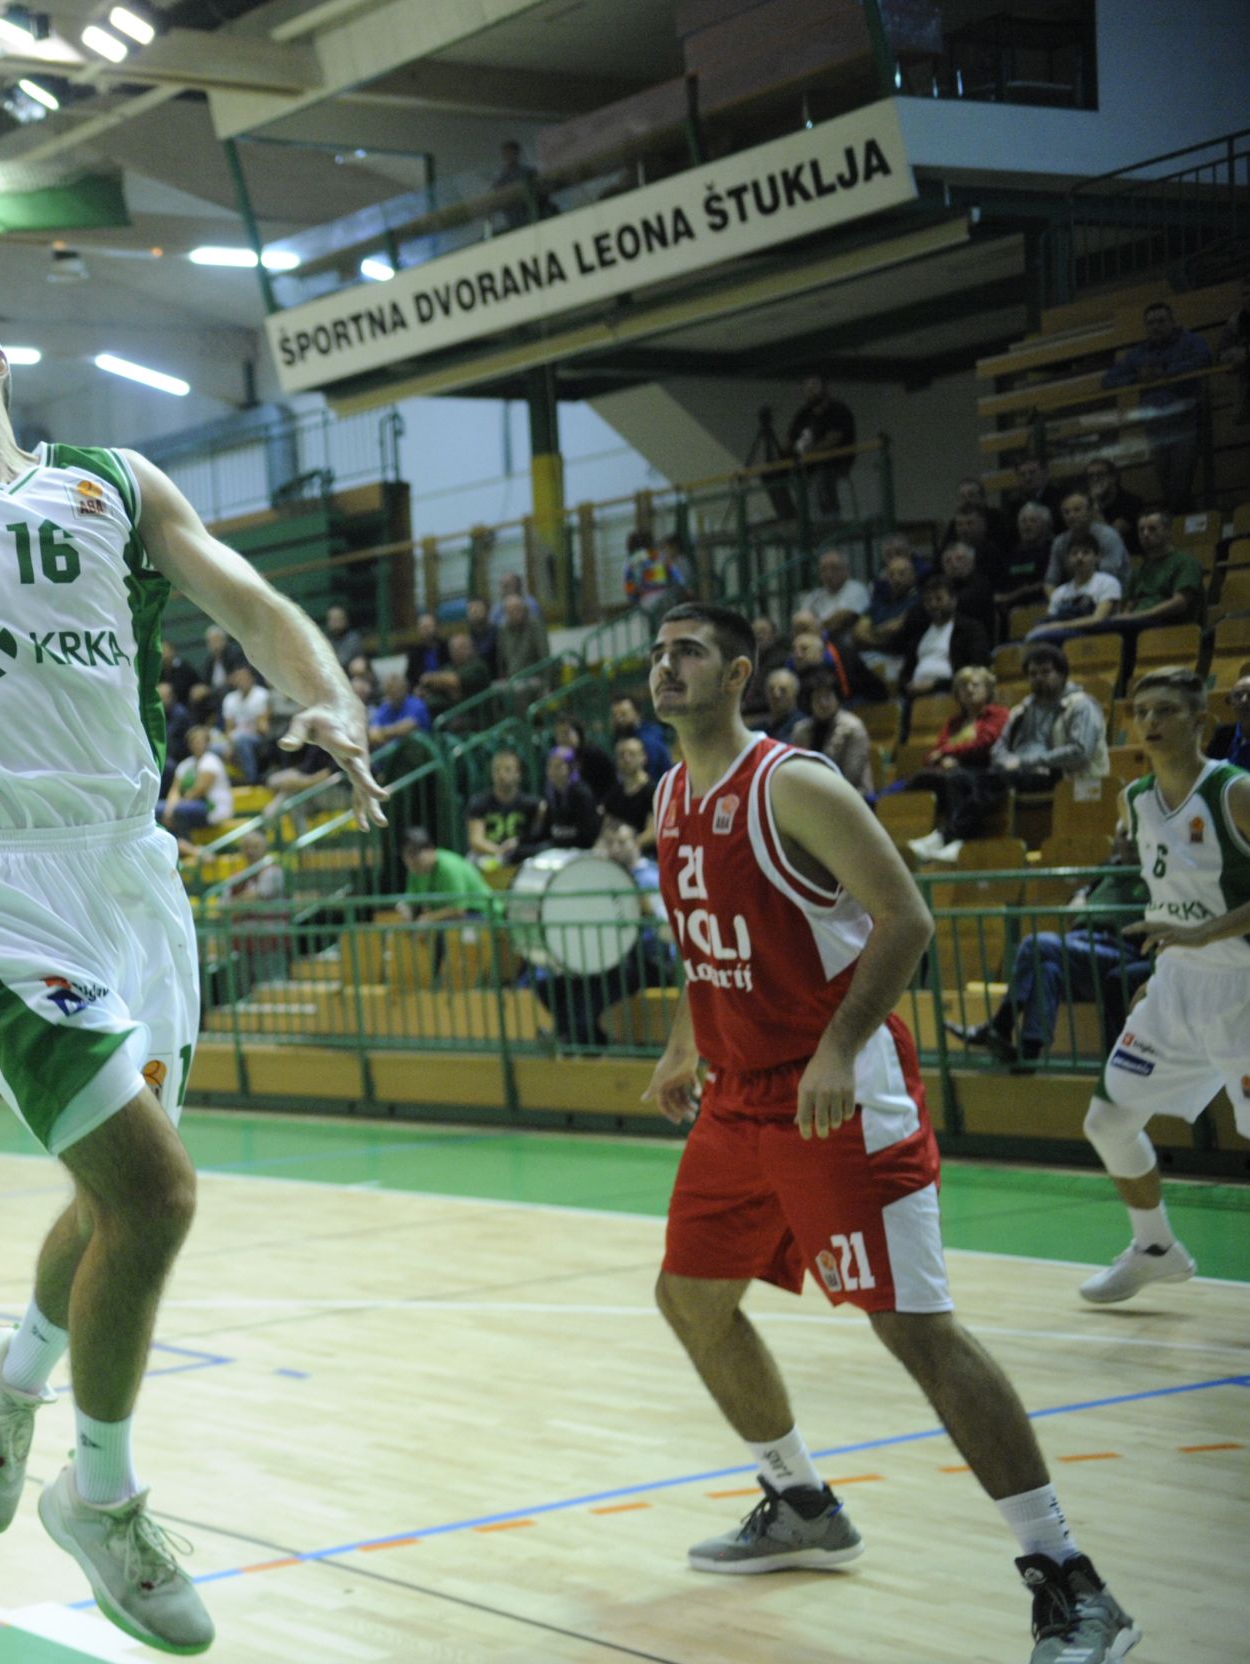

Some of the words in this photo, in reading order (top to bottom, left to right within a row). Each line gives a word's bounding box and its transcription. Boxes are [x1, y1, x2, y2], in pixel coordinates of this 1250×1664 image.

[278, 300, 408, 368] ŠPORTNA
[412, 249, 568, 324] DVORANA
[573, 205, 697, 276] LEONA
[703, 137, 893, 233] ŠTUKLJA
[79, 499, 106, 515] ABA
[6, 519, 81, 585] 16
[29, 631, 132, 667] KRKA
[678, 845, 709, 901] 21
[1153, 844, 1169, 879] 6
[830, 1231, 876, 1292] 21
